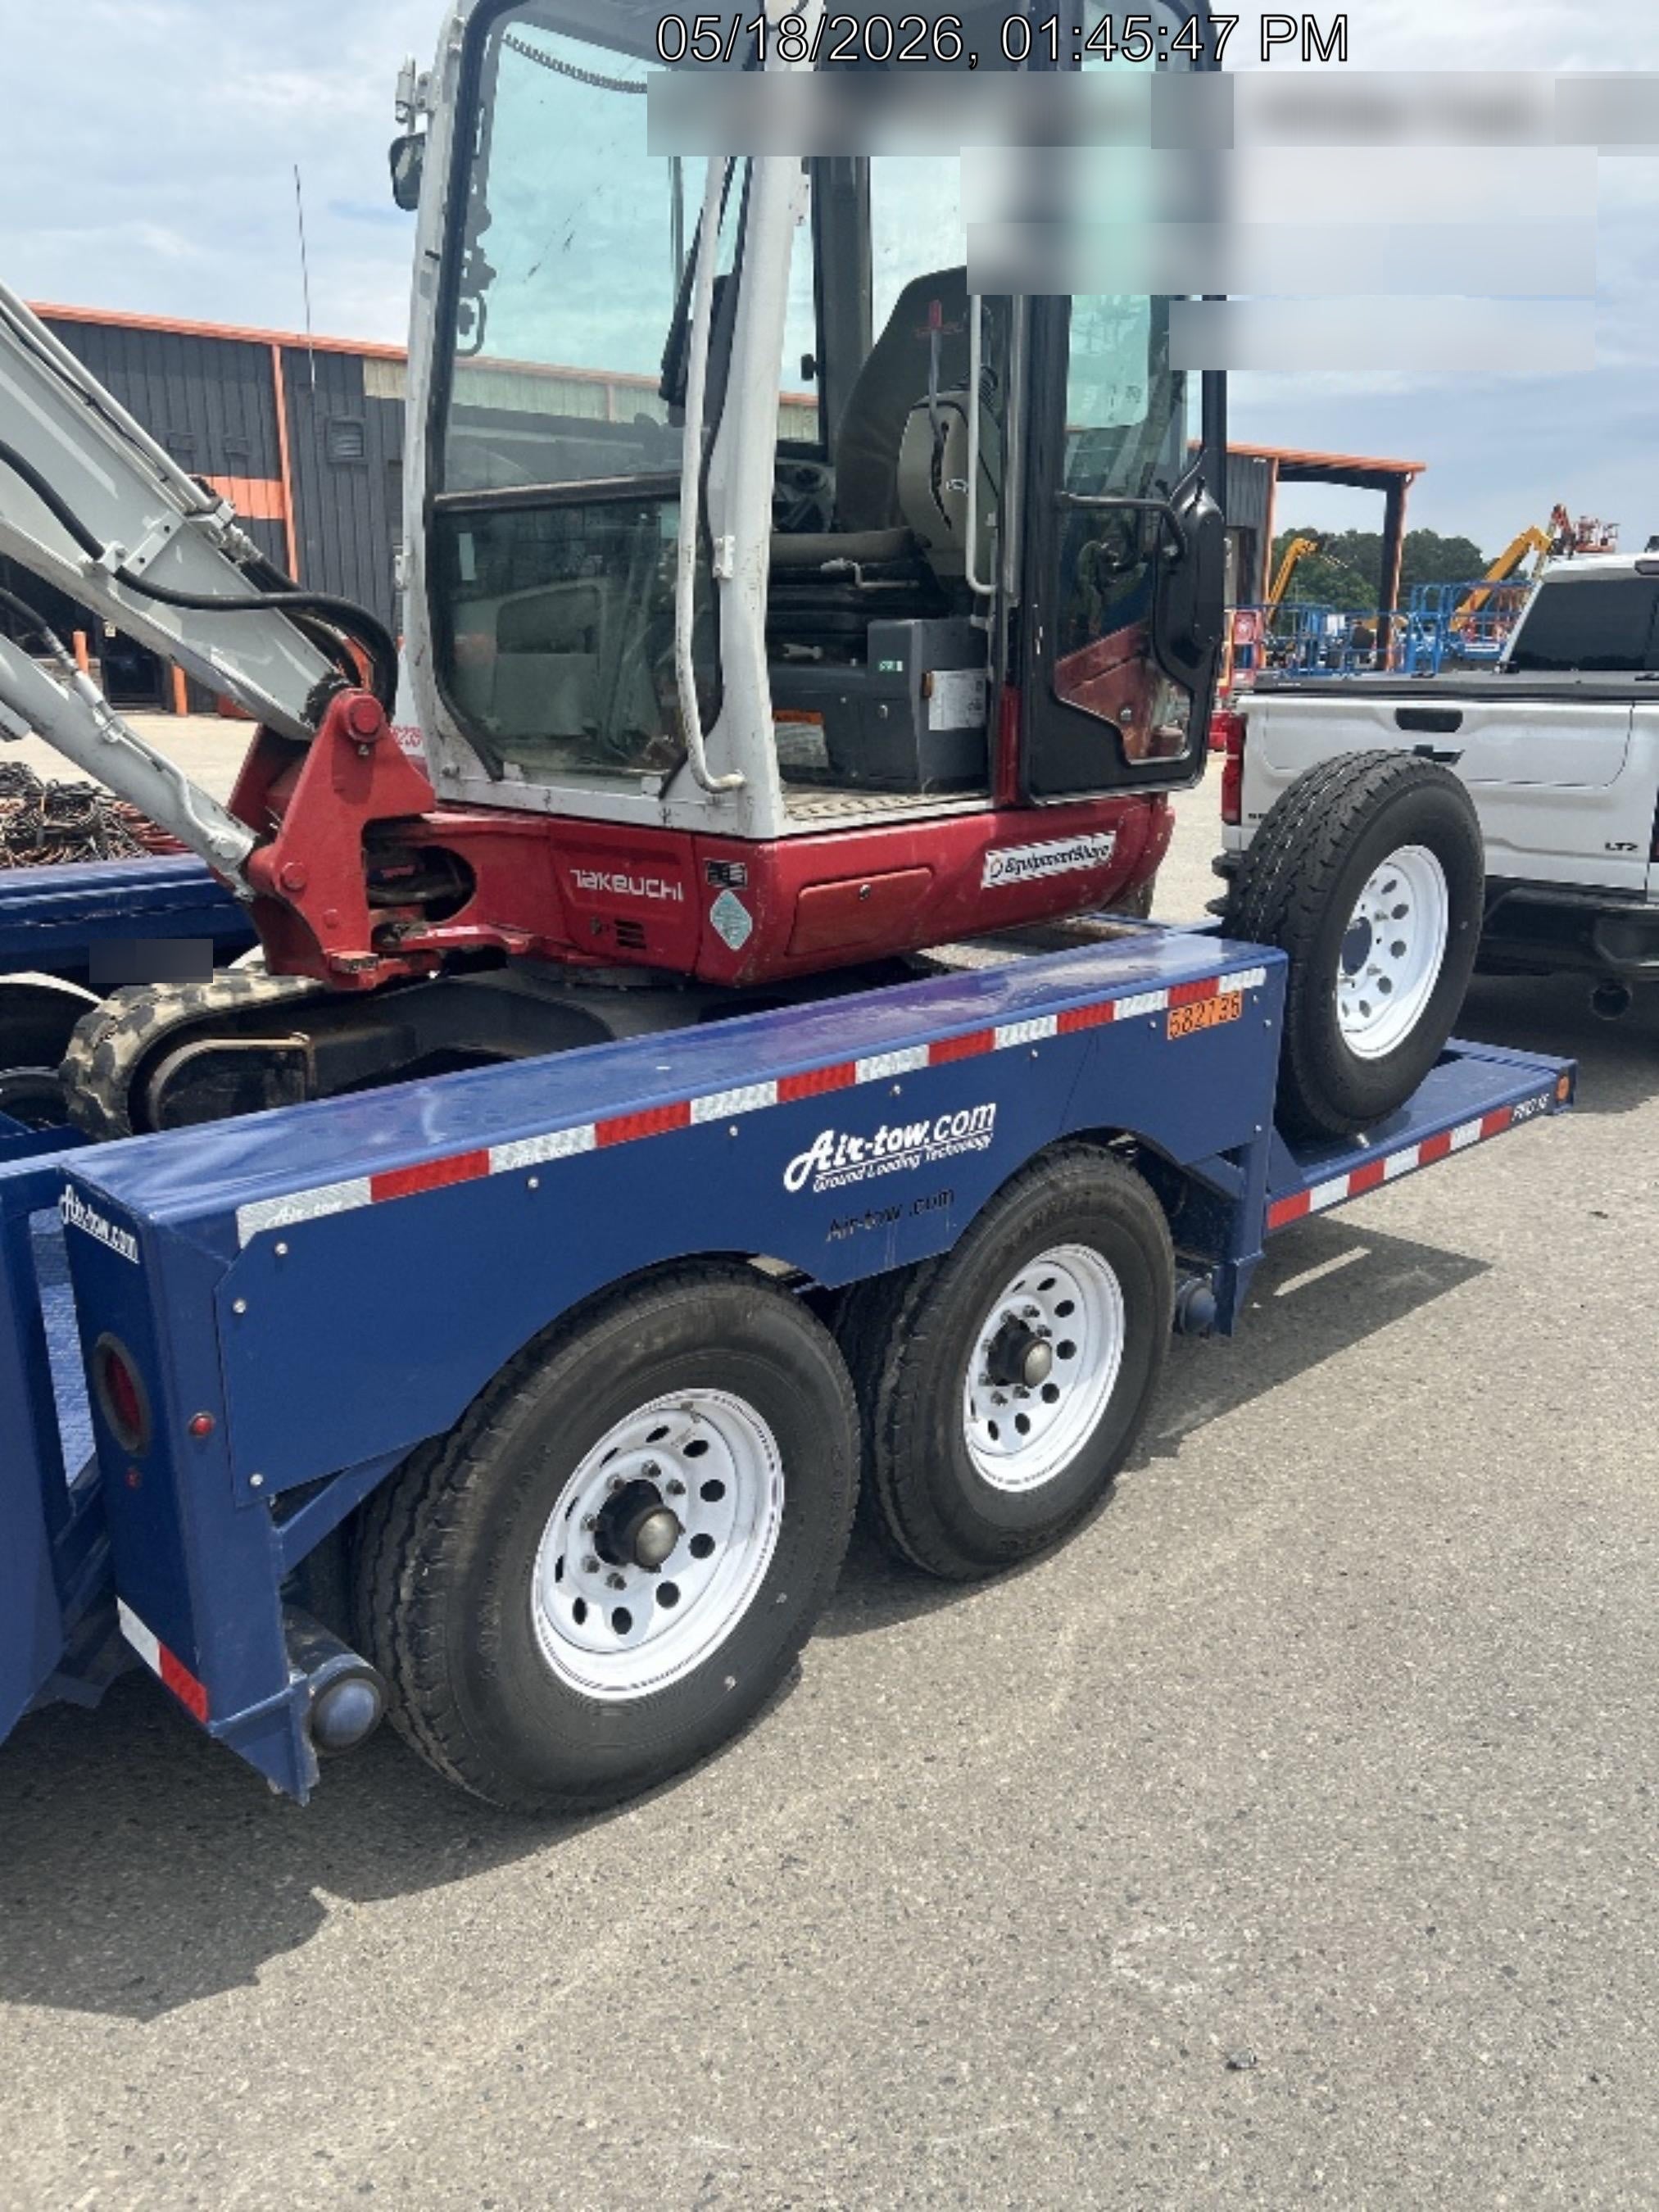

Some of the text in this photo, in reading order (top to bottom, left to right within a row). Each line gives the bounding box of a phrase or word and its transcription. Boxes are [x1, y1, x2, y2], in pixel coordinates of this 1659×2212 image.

[783, 1102, 996, 1193] Air-tow.com
[868, 1158, 920, 1180] Loading
[926, 1133, 994, 1162] Technology
